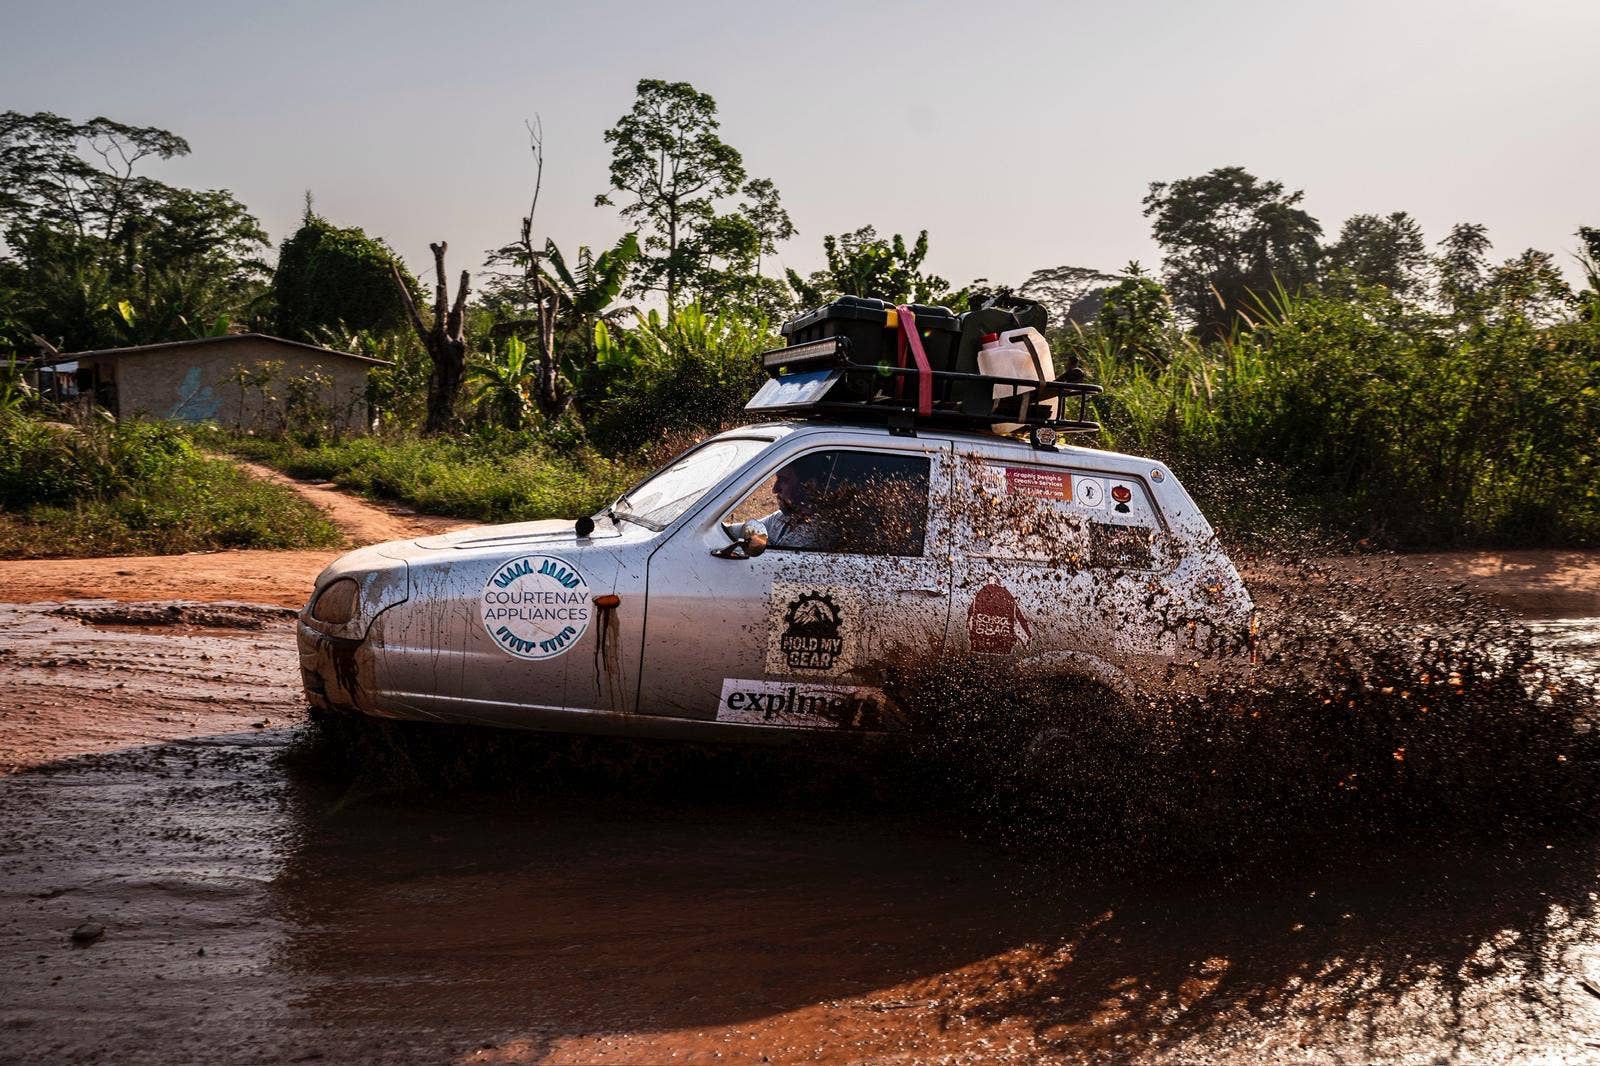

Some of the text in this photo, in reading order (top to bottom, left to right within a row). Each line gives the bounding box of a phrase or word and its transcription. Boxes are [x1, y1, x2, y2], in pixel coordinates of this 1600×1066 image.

[1013, 472, 1036, 480] Graphic
[485, 591, 589, 605] COURTENAY
[485, 608, 588, 621] APPLIANCES
[783, 635, 841, 653] HOLD MY
[789, 650, 832, 667] GEAR
